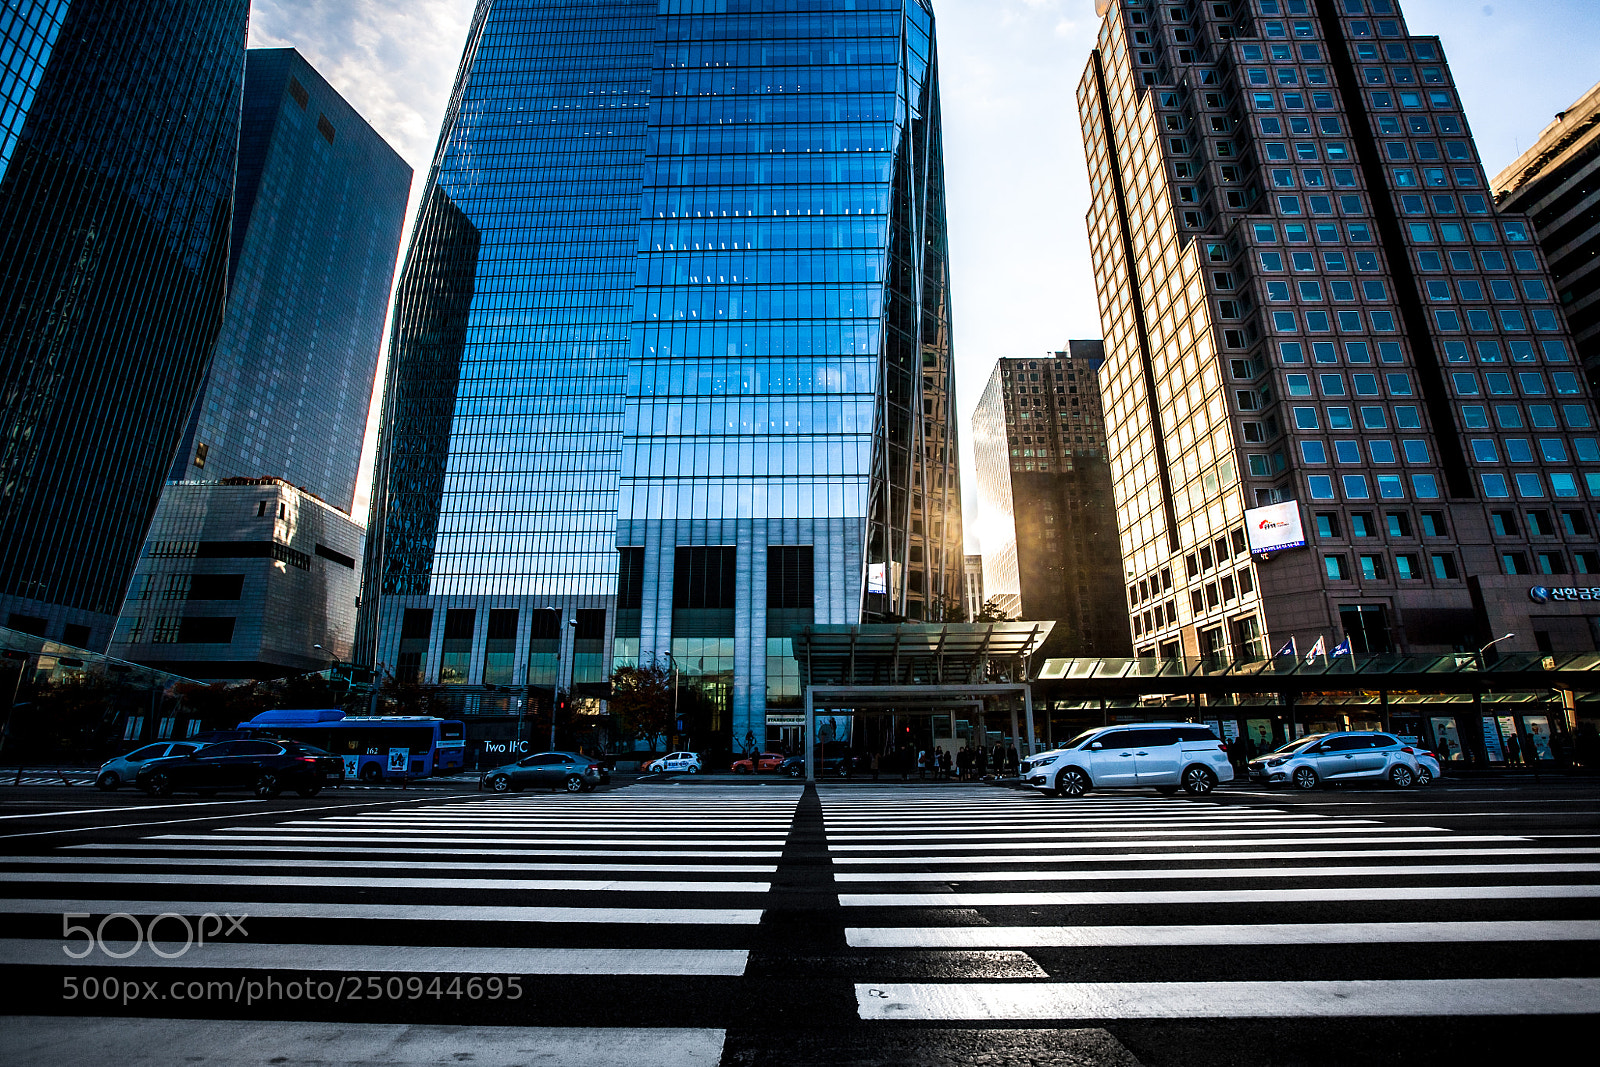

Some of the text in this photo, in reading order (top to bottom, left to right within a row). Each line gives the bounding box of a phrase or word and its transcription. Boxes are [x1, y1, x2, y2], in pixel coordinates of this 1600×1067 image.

[366, 747, 379, 755] 162
[484, 740, 529, 753] Two IFC
